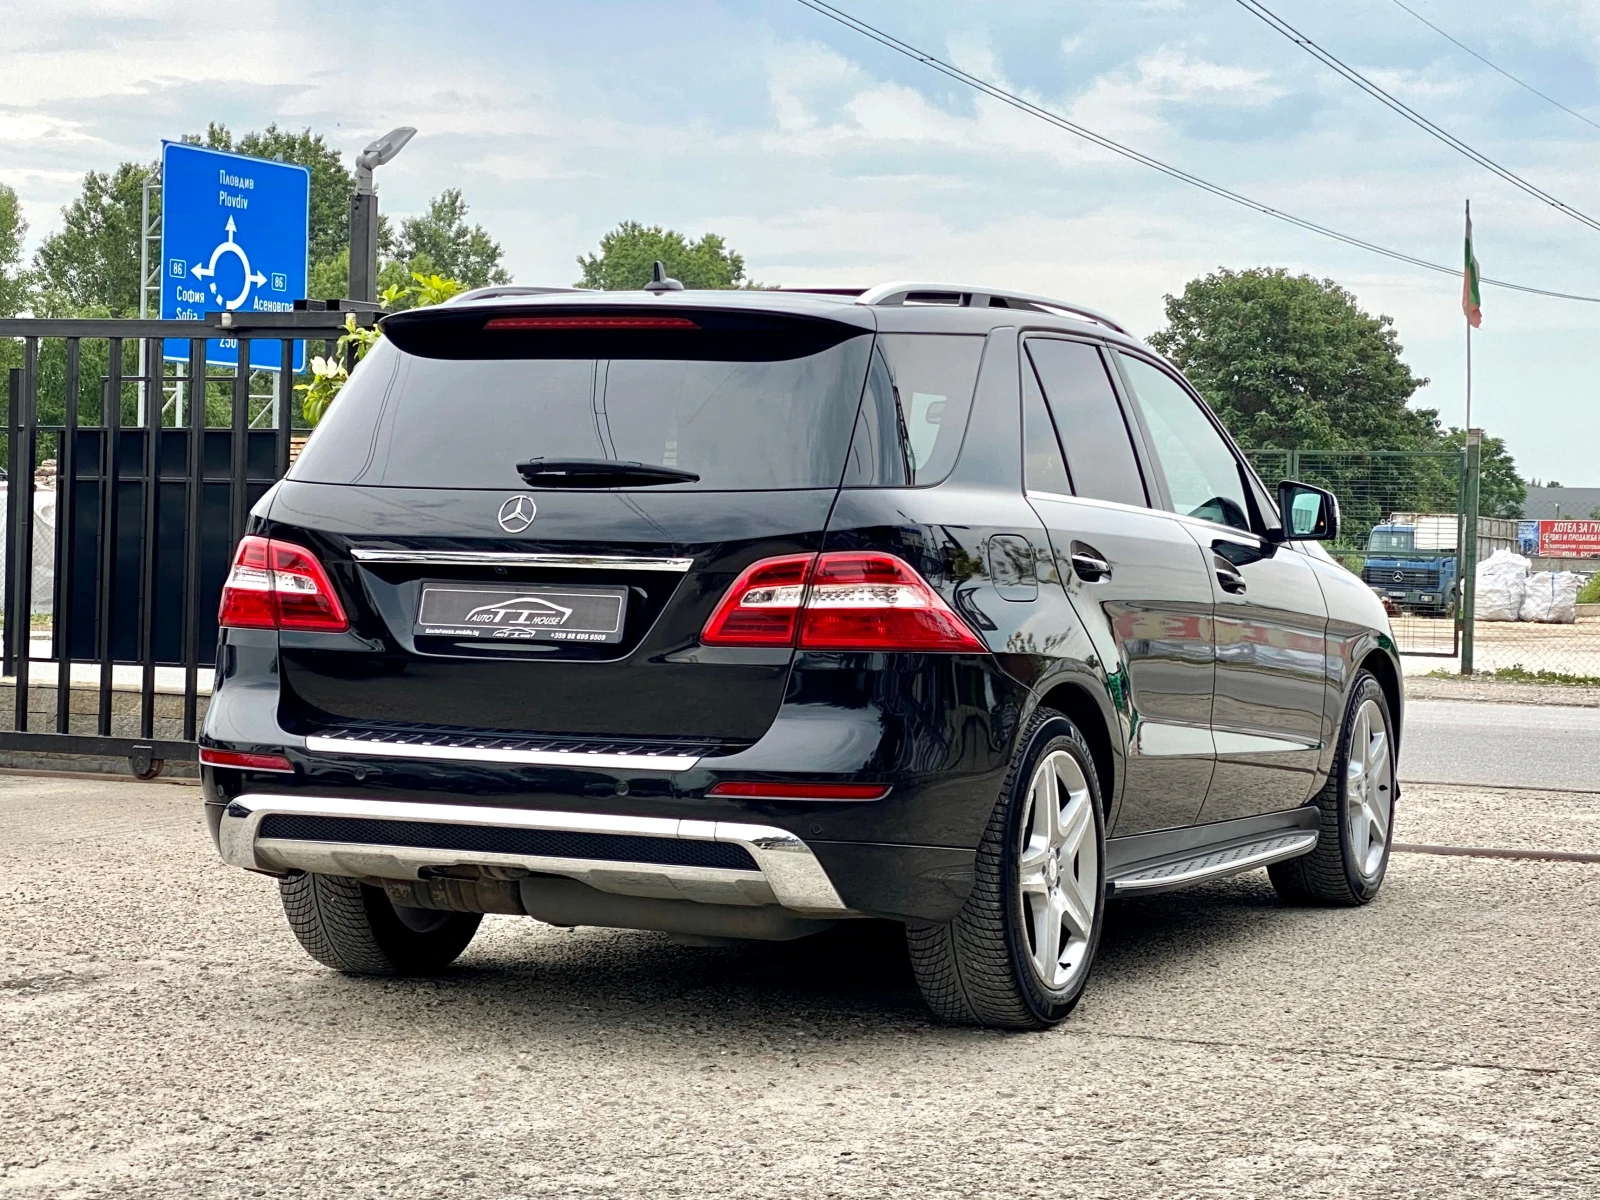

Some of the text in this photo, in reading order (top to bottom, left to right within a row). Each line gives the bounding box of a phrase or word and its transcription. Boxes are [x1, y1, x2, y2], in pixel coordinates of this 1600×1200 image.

[219, 170, 254, 190] Пловдив
[219, 191, 248, 210] Plovdiv
[173, 263, 183, 275] 86
[274, 276, 284, 288] 86
[176, 286, 205, 304] София
[253, 296, 294, 312] Асеновгра
[1553, 523, 1577, 533] ХОТЕЛ
[1578, 523, 1588, 533] ЗА
[470, 614, 494, 622] AUTO
[532, 616, 561, 625] HOUSE
